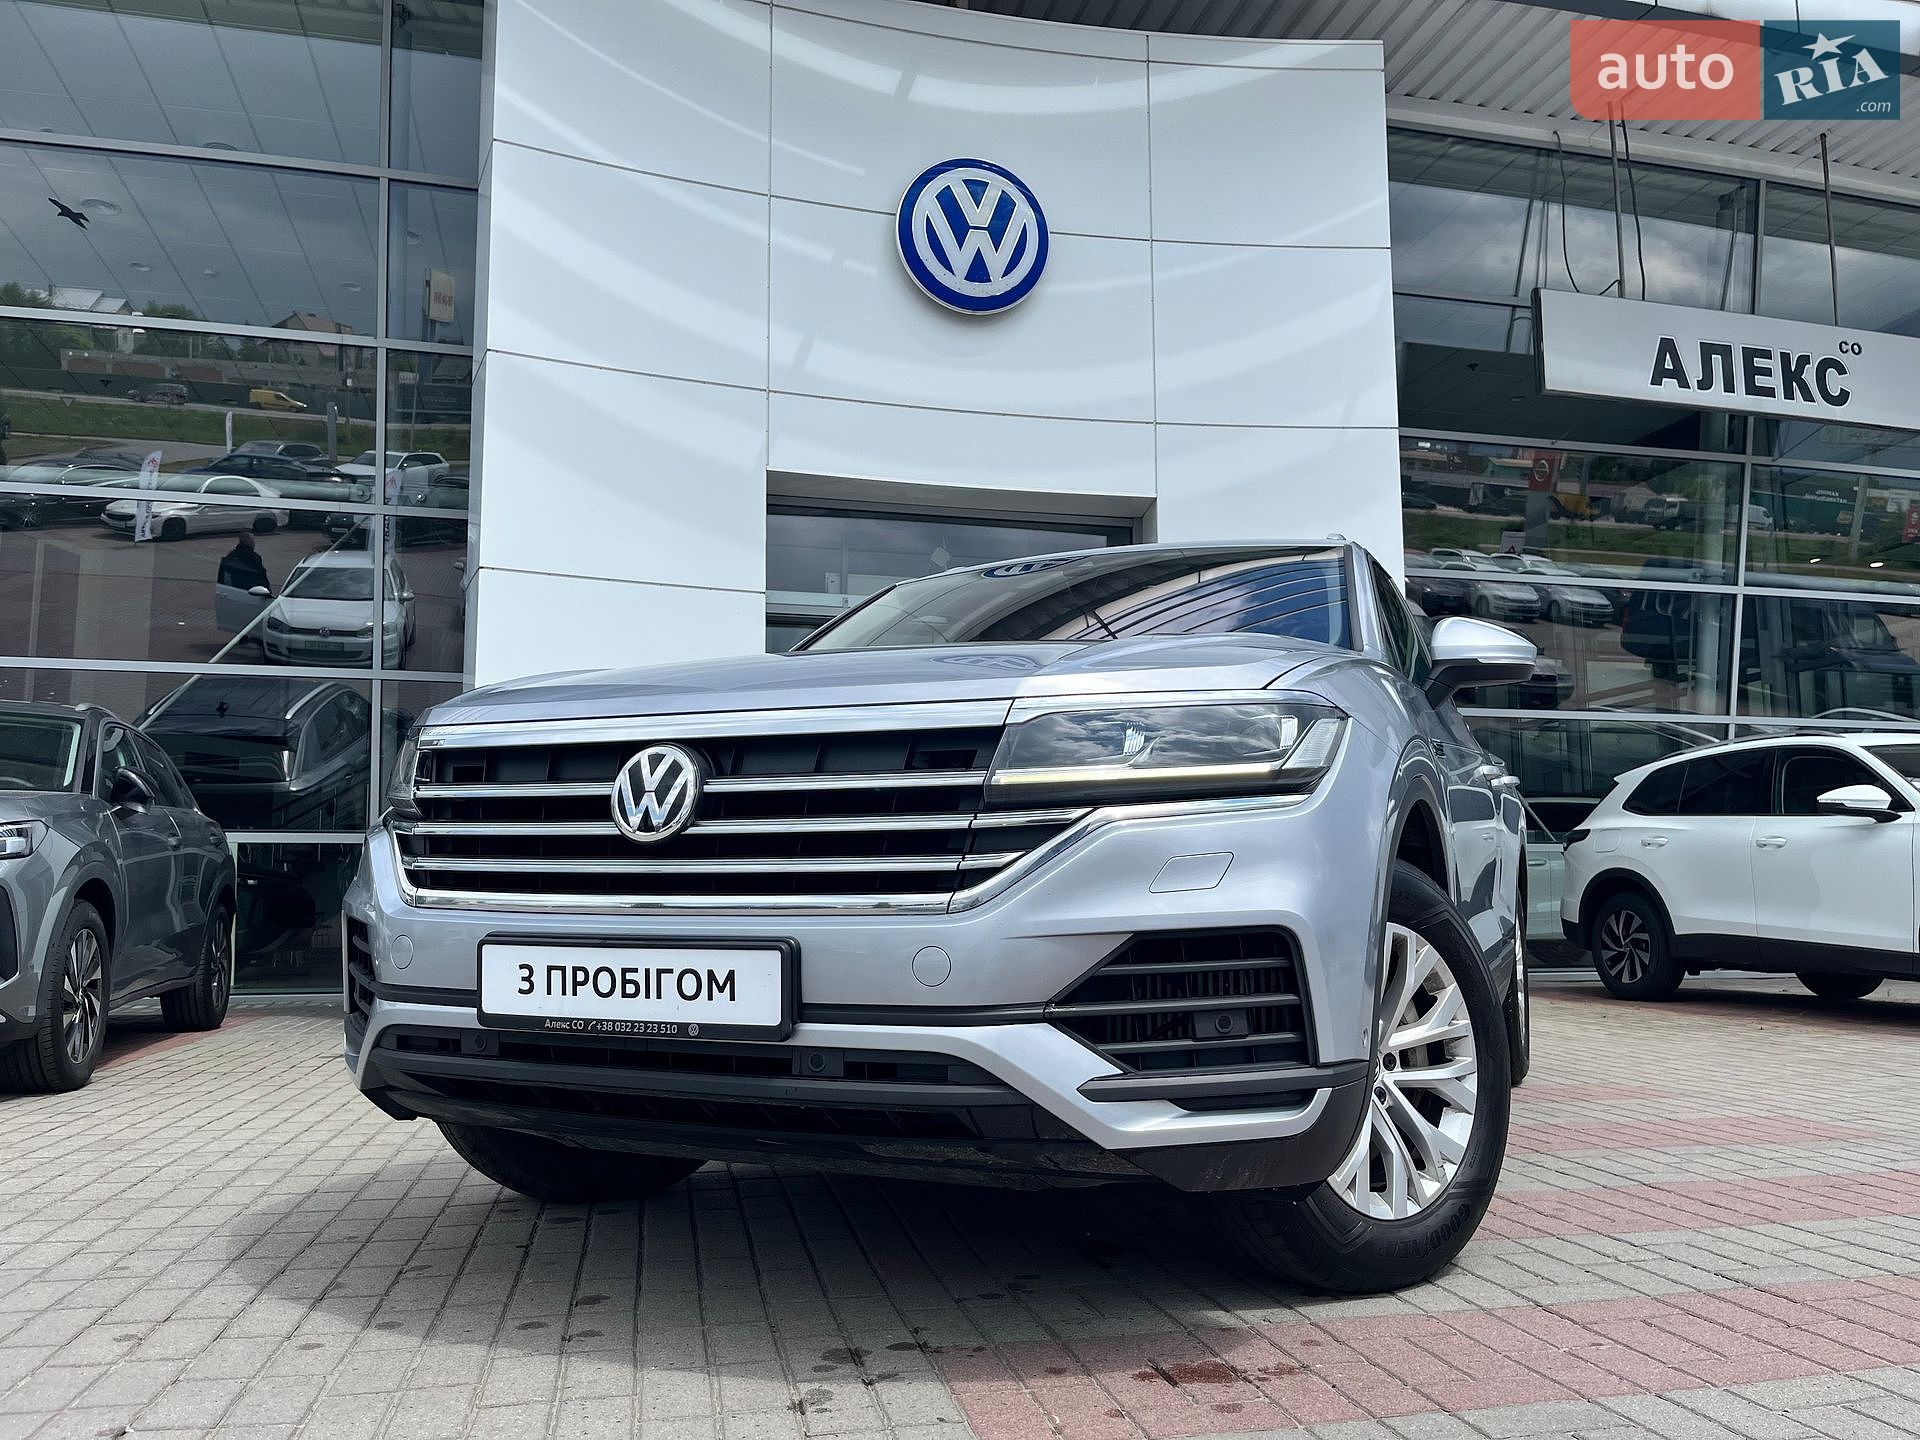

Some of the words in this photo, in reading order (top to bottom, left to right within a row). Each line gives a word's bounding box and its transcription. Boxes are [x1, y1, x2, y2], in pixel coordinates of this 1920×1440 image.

[1649, 335, 1852, 408] АЛЕКС
[546, 964, 736, 1002] ПРОБІГОМ
[544, 1019, 570, 1029] Алекс
[596, 1021, 613, 1031] +38
[614, 1022, 632, 1032] 032
[633, 1023, 645, 1033] 23
[646, 1023, 659, 1033] 23
[660, 1024, 678, 1034] 510
